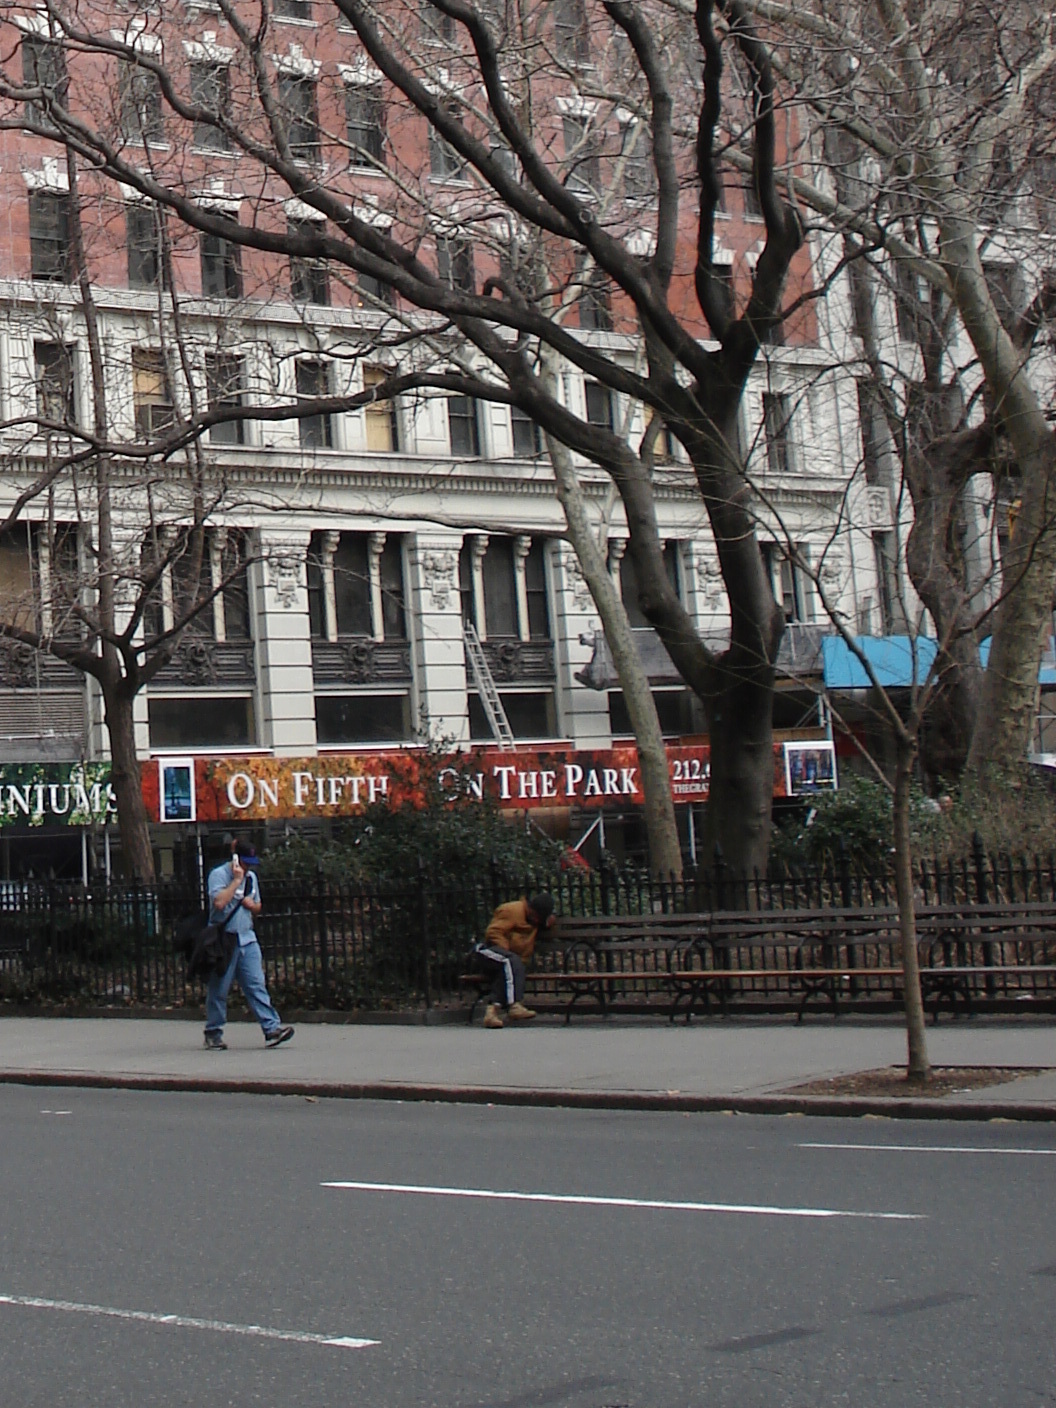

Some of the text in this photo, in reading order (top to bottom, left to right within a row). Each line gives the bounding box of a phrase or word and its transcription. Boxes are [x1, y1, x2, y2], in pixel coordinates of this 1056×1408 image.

[227, 764, 640, 809] ON FIFTH ON THE PARK
